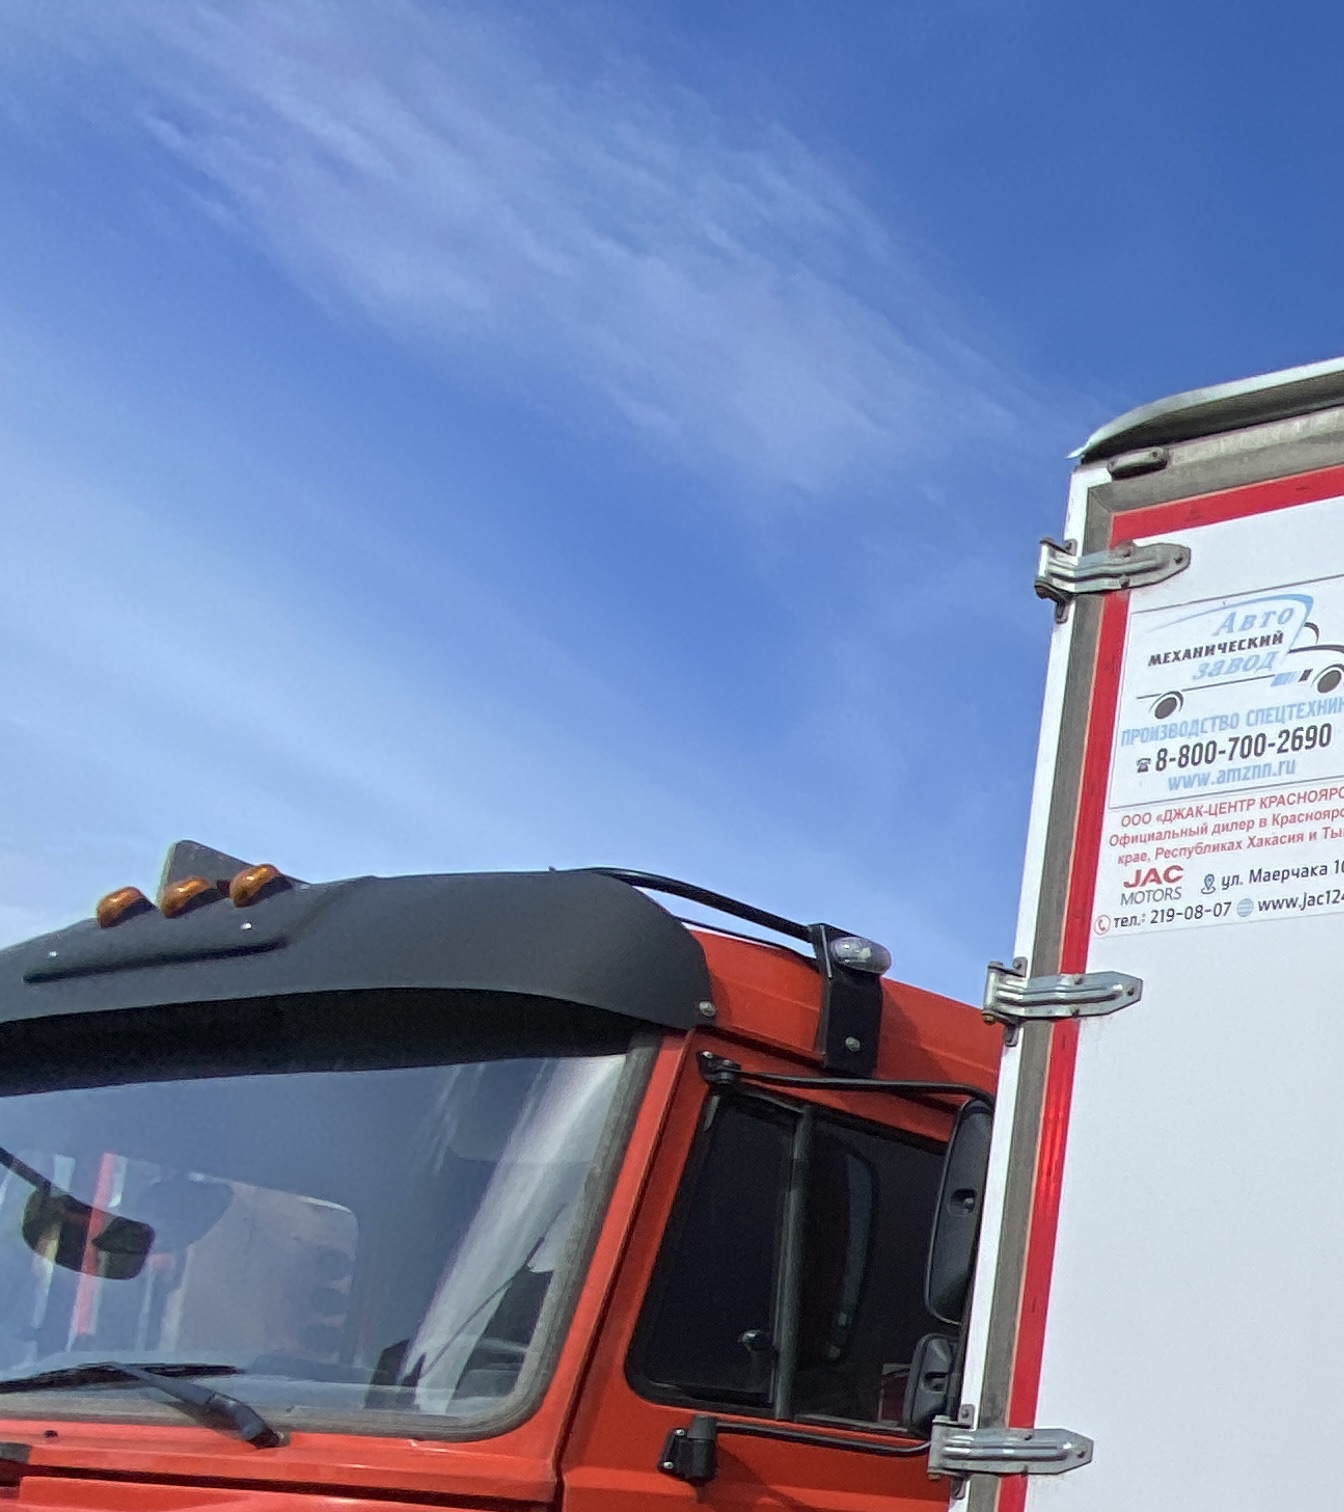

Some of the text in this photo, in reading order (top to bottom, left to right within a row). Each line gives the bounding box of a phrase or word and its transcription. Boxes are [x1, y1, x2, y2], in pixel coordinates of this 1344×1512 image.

[1211, 607, 1295, 636] Авто
[1148, 630, 1284, 667] МЕХАНИЧЕСКИЙ
[1120, 712, 1240, 747] ПРОИЗВОДСТВО
[1155, 723, 1332, 772] 8-800-700-2690
[1168, 758, 1297, 791] www.amznn.ru
[1121, 812, 1152, 827] ООО
[1156, 798, 1256, 824] «ДЖАК-ЦЕНТР
[1109, 822, 1209, 848] Официальный
[1211, 818, 1256, 836] дилер
[1258, 818, 1268, 828] в
[1118, 851, 1151, 867] крае,
[1154, 840, 1243, 860] Республиках
[1246, 832, 1304, 849] Хакасия
[1308, 831, 1318, 841] и
[1123, 864, 1184, 889] JAC
[1221, 874, 1244, 890] ул.
[1248, 864, 1328, 884] Маерчака
[1120, 886, 1182, 906] MOTORS
[1150, 901, 1232, 924] 219-08-07
